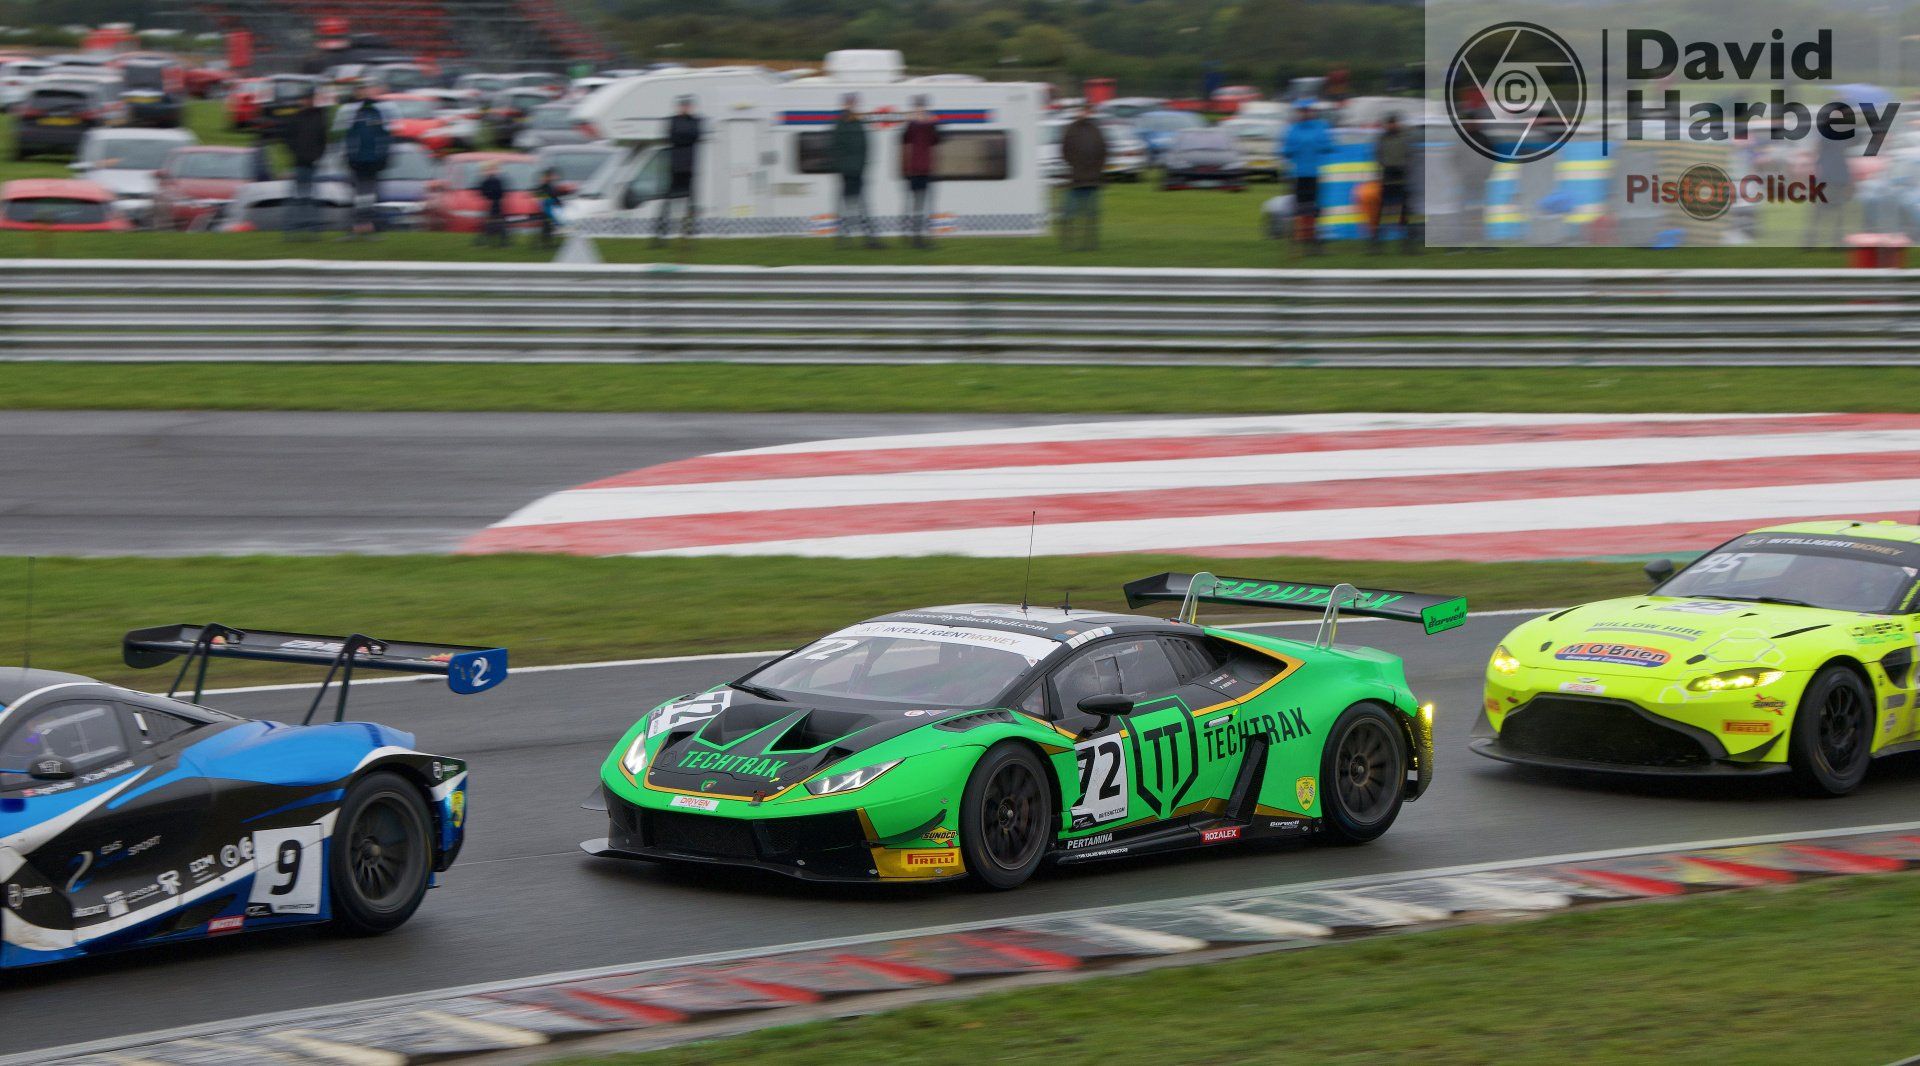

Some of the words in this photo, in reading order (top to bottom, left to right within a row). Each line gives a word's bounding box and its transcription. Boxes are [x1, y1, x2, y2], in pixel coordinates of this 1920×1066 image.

[1594, 621, 1660, 631] WILLOW
[1664, 624, 1706, 636] HIRE
[1564, 643, 1581, 654] M
[1589, 643, 1667, 662] O'Brien
[472, 656, 491, 687] 2
[677, 751, 789, 778] TECHTRAK
[1072, 740, 1122, 808] 72
[680, 796, 711, 807] DRIVEN
[922, 831, 956, 839] SUNOCO
[1067, 832, 1113, 850] PERTAMINA
[1204, 829, 1237, 841] ROZALEX
[270, 839, 302, 895] 9
[907, 852, 954, 865] PIRELLI
